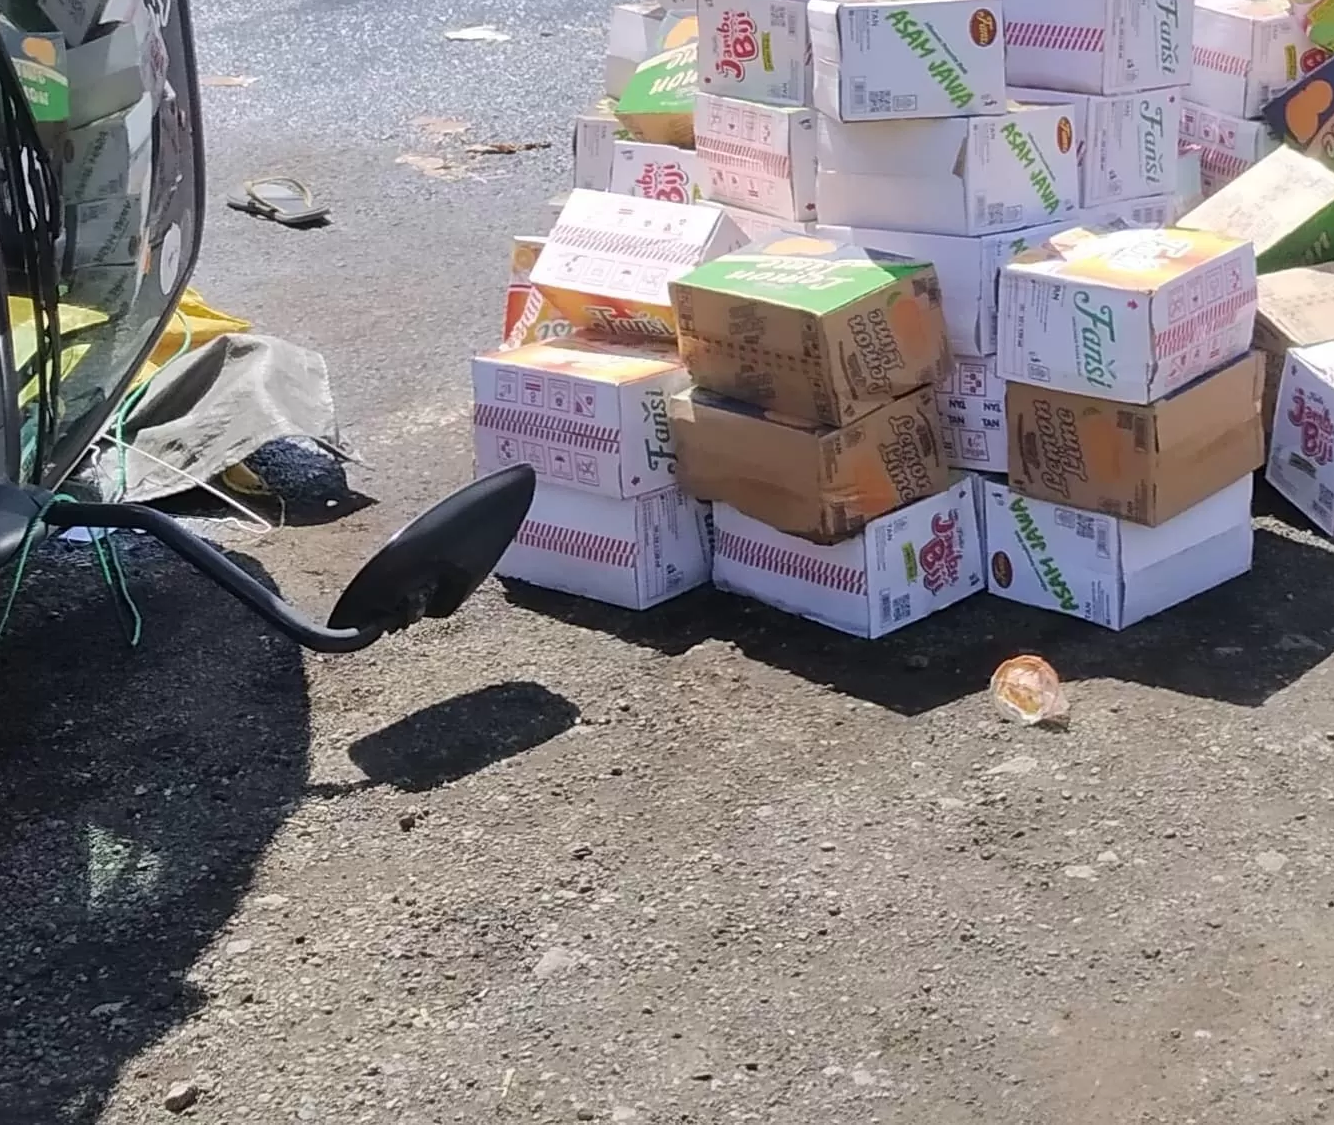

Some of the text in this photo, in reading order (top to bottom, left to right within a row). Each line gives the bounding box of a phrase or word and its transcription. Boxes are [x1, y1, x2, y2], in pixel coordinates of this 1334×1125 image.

[884, 9, 937, 59] ASAM
[927, 59, 976, 110] JAWA
[1000, 122, 1060, 215] ASAM JAWA
[847, 314, 894, 395] Lemon
[868, 308, 905, 370] Lime
[876, 442, 916, 505] Lime
[887, 415, 932, 493] Lemon
[1032, 398, 1071, 500] Lemon
[1058, 406, 1088, 483] Lime
[1009, 497, 1079, 610] ASAM JAWA
